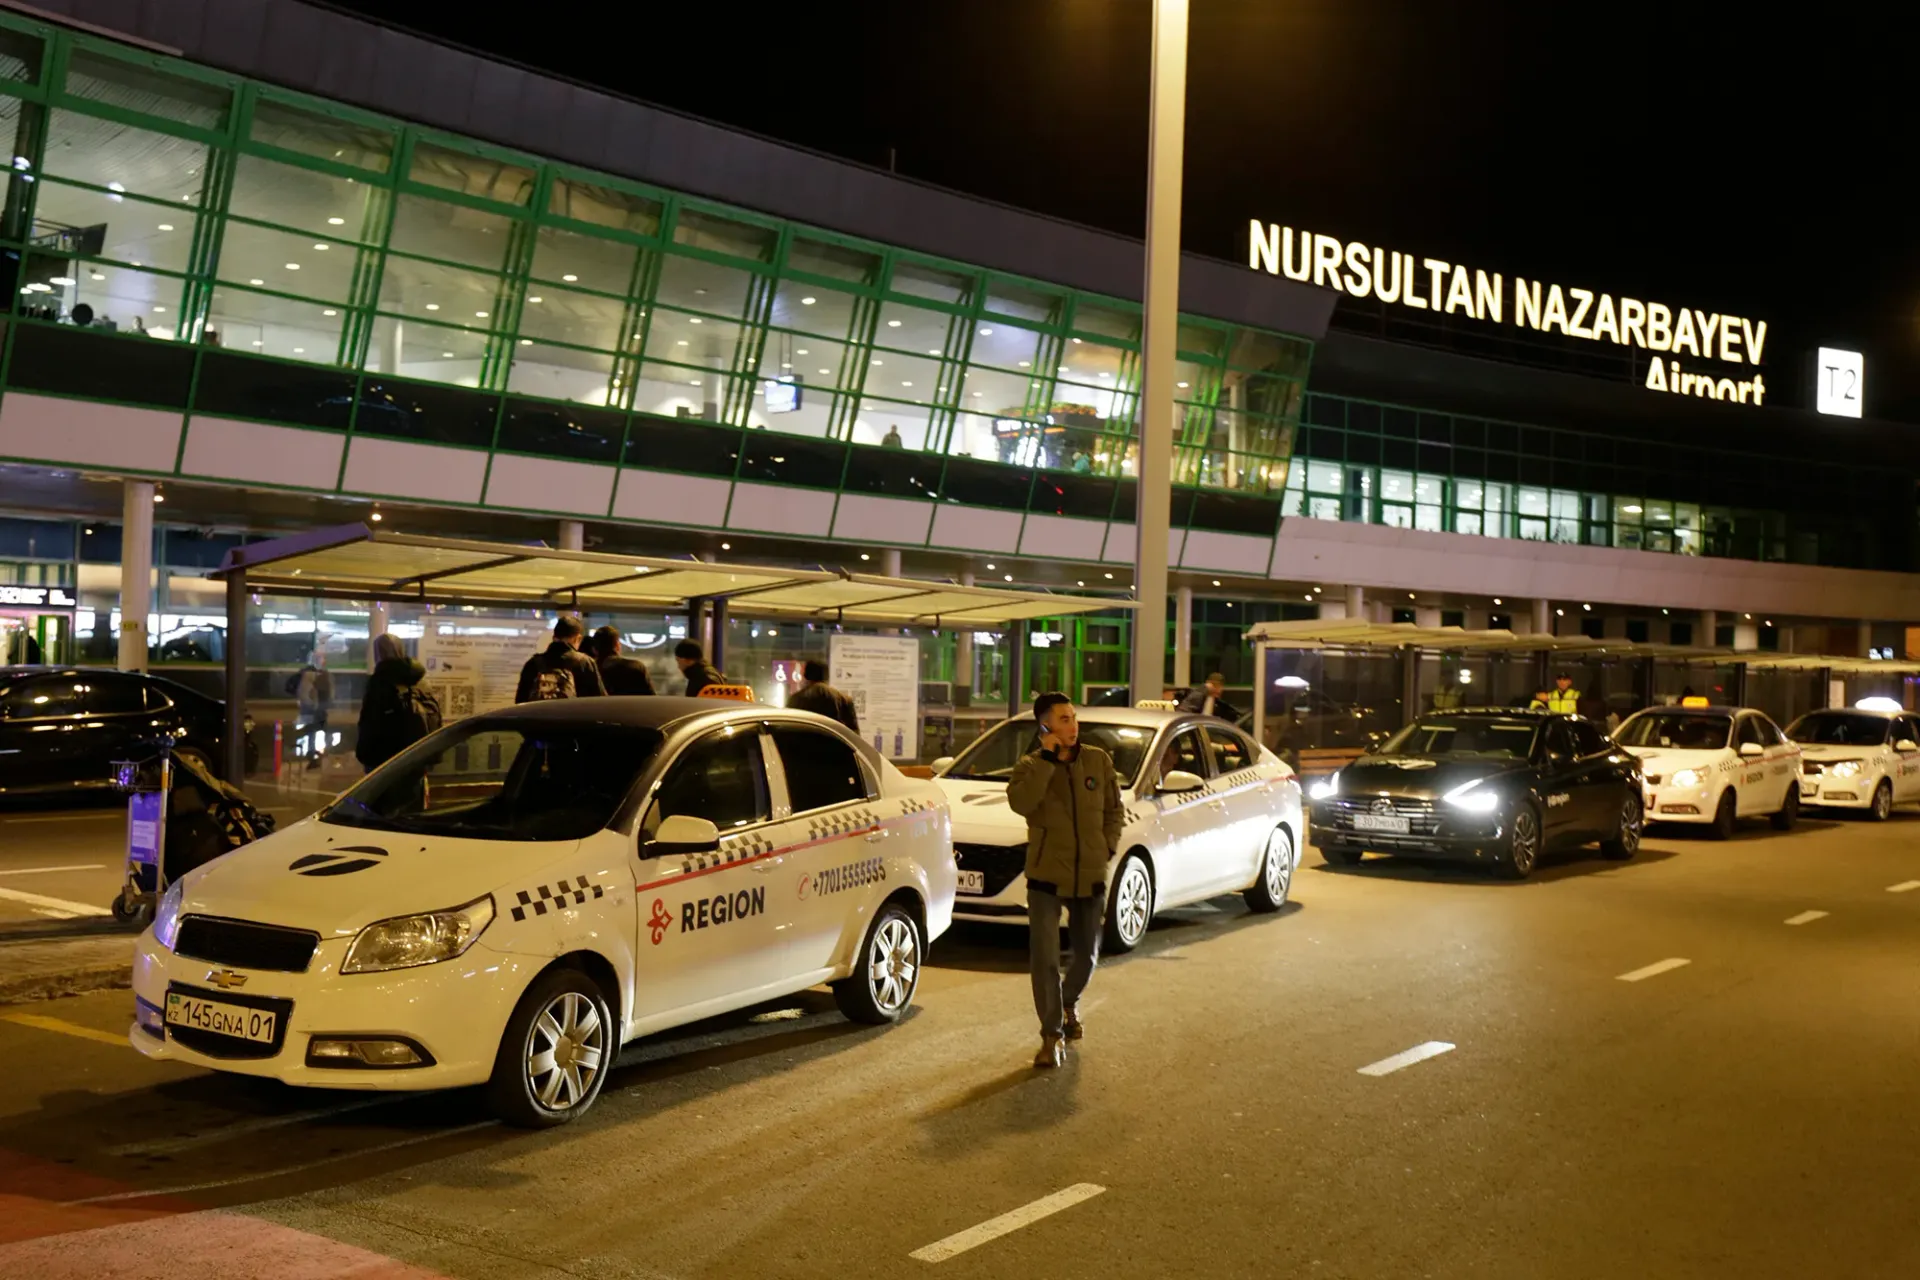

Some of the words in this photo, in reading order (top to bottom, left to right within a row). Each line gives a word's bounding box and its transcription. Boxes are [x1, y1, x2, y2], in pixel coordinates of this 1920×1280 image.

[1249, 218, 1502, 323] NURSULTAN
[1515, 277, 1767, 365] NAZARBAYEV
[1824, 365, 1857, 401] T2
[681, 886, 765, 933] REGION
[167, 1011, 178, 1022] KZ
[183, 1000, 244, 1035] 145GNA
[249, 1013, 273, 1040] 01
